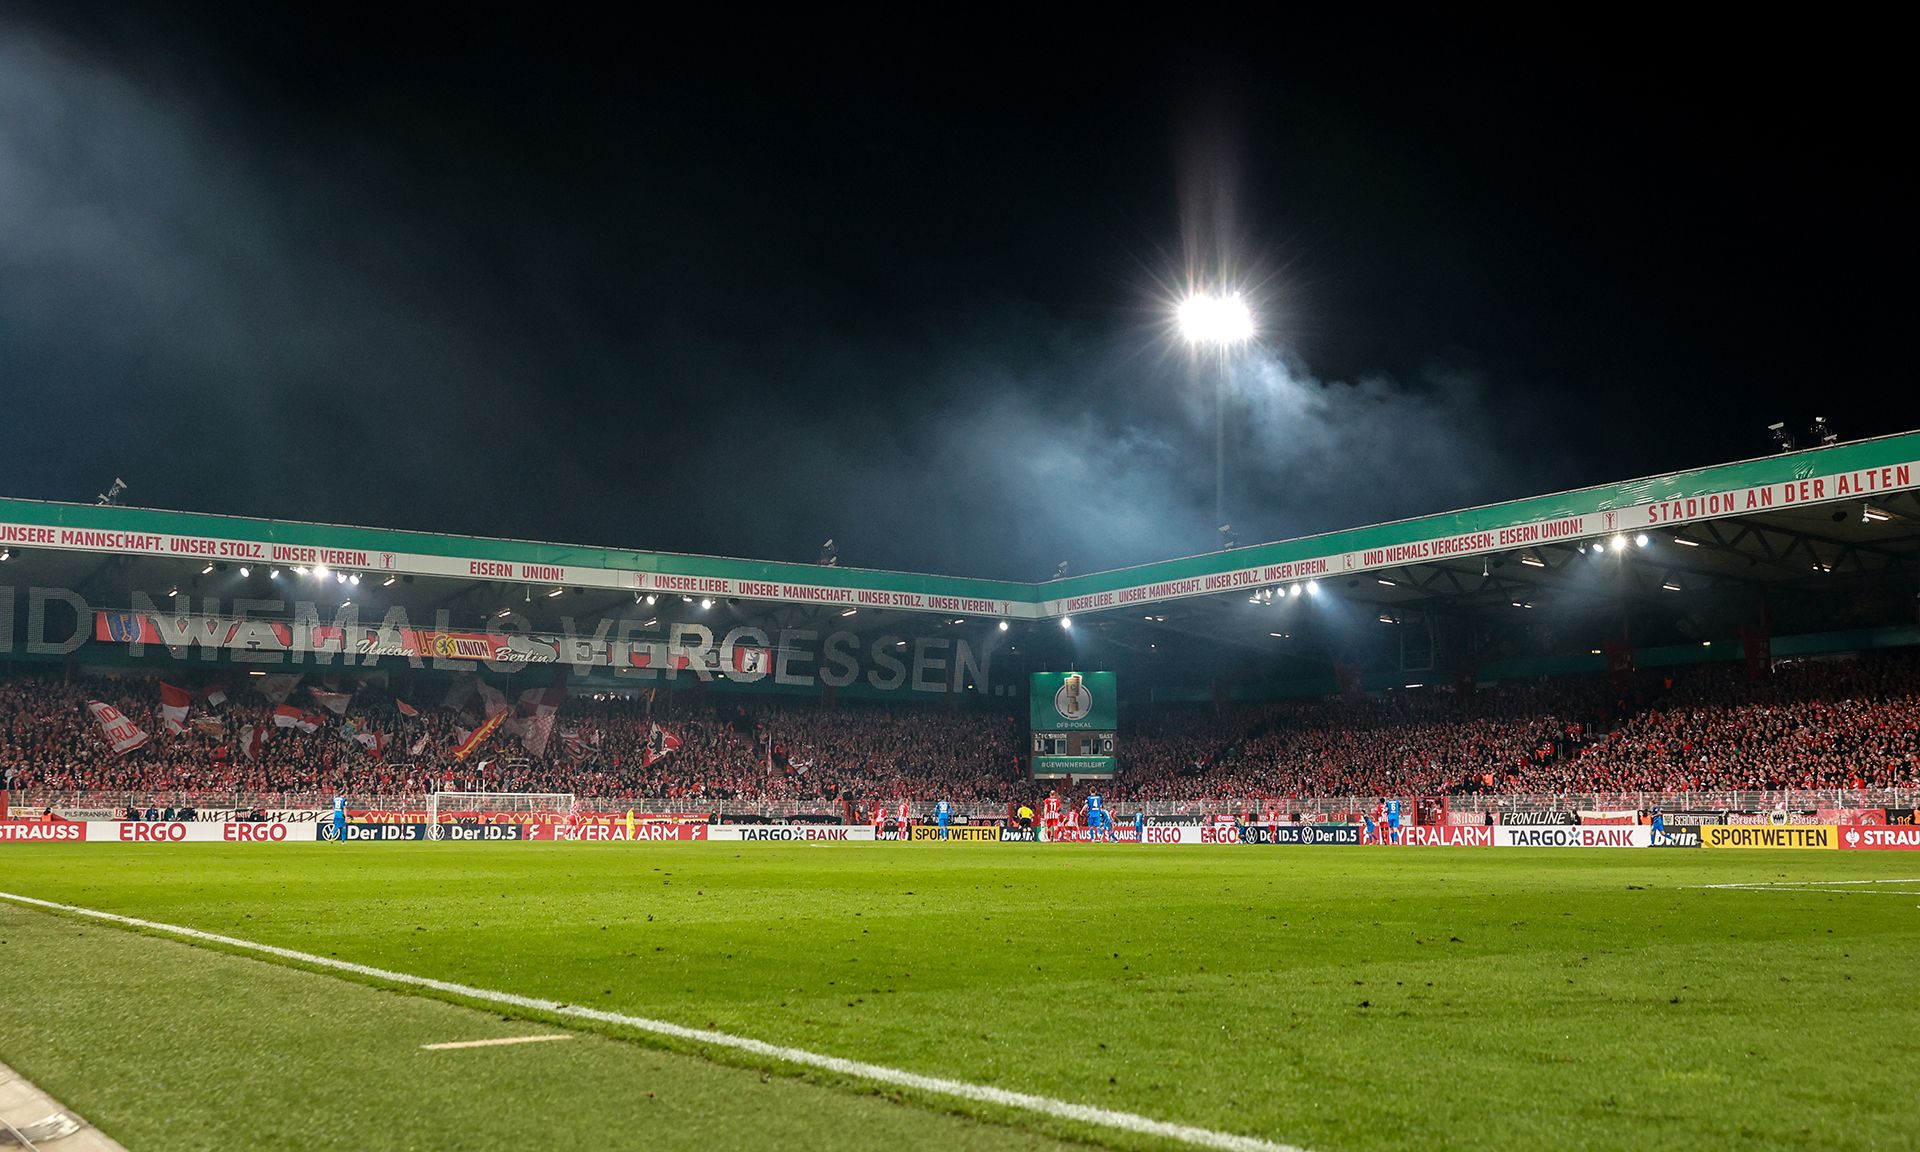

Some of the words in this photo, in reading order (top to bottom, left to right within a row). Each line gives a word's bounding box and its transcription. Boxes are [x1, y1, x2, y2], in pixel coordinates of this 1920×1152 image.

[1648, 493, 1735, 523] STADION
[1746, 487, 1772, 509] AN
[1785, 478, 1825, 503] DER
[1837, 465, 1910, 495] ALTEN
[61, 530, 164, 551] MANNSCHAFT.
[170, 538, 216, 554] UNSER
[220, 541, 265, 559] STOLZ.
[273, 546, 316, 562] UNSER
[320, 549, 370, 567] VEREIN.
[1363, 550, 1383, 566] UND
[1386, 542, 1429, 562] NIEMALS
[1431, 533, 1495, 556] VERGESSEN:
[1499, 525, 1539, 545] EISERN
[1541, 518, 1583, 538] UNION!
[469, 561, 513, 578] EISERN
[522, 565, 564, 581] UNION!
[1067, 596, 1093, 611] UNSERE
[1094, 593, 1115, 608] LIEBE.
[1118, 587, 1146, 603] UNSERE
[1149, 579, 1201, 598] MANNSCHAFT.
[1205, 575, 1231, 590] UNSER
[1233, 570, 1261, 587] STOLZ.
[1264, 566, 1292, 581] UNSER
[1294, 559, 1329, 576] VEREIN.
[654, 575, 697, 591] UNSERE
[699, 579, 732, 593] LIEBE.
[739, 582, 779, 597] UNSERE
[783, 585, 854, 602] MANNSCHAFT.
[858, 591, 890, 605] UNSER
[892, 593, 924, 608] STOLZ.
[928, 596, 959, 610] UNSER
[961, 599, 997, 613] VEREIN.
[0, 585, 92, 654] D
[128, 590, 532, 673] NIEMALS
[456, 638, 489, 657] UNION
[1049, 801, 1057, 811] 11
[1092, 798, 1098, 808] 4
[1390, 802, 1396, 811] 6
[1502, 811, 1567, 825] FRONTLINE
[119, 823, 186, 841] ERGO
[223, 823, 287, 841] ERGO
[347, 825, 378, 840] Der
[451, 825, 480, 840] Der
[554, 825, 679, 840] FYERAARM
[1104, 830, 1136, 840] SRAUSS
[1147, 827, 1181, 843] ERGO
[1278, 830, 1298, 842] ID.5
[1316, 830, 1334, 842] Der
[1335, 830, 1357, 842] ID.5
[1379, 826, 1491, 846] YERALARM
[1711, 829, 1827, 846] SPORTWETTEN
[1863, 830, 1920, 845] STRAU
